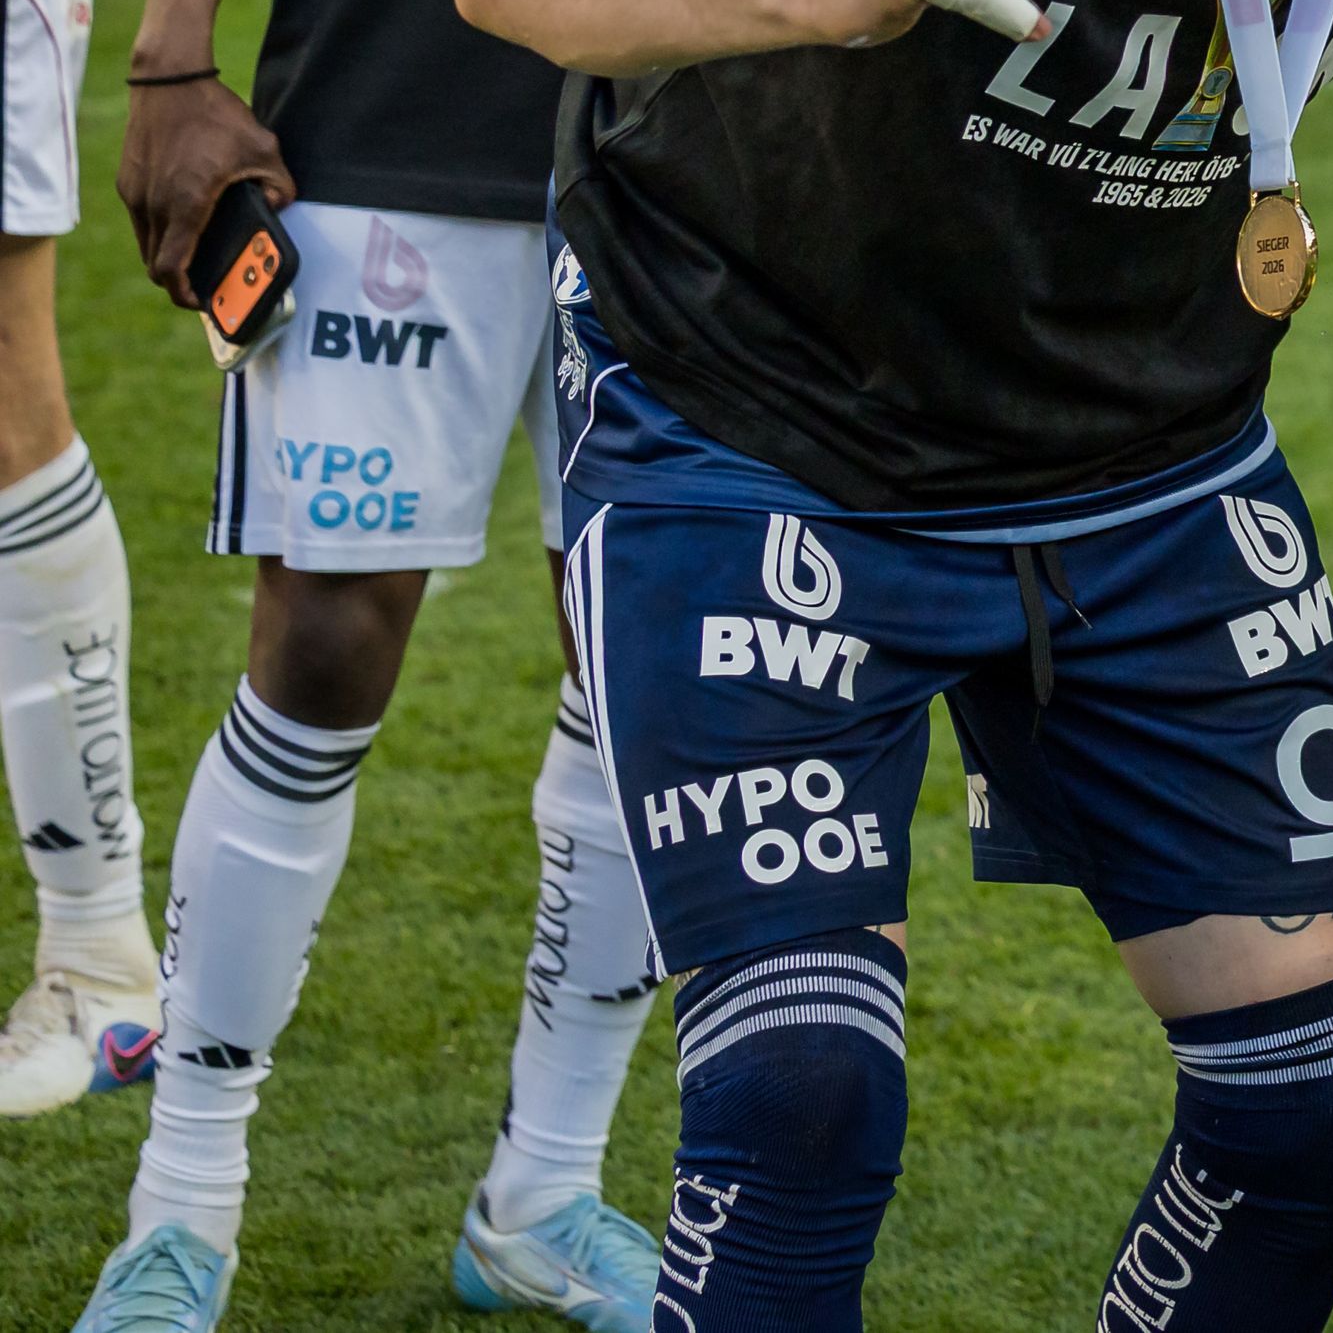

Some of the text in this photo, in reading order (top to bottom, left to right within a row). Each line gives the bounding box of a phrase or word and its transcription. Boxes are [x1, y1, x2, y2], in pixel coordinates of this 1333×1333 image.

[962, 114, 988, 143] ES
[992, 122, 1047, 161] WAR
[1047, 143, 1078, 168] VÜ
[1078, 148, 1152, 179] Z'LANG
[1156, 159, 1200, 183] HER!
[1092, 180, 1212, 209] 1965 & 2026
[1256, 236, 1289, 254] SIEGER
[1261, 259, 1285, 275] 2026
[311, 310, 448, 370] BWT
[276, 439, 393, 486] YPO
[309, 490, 421, 532] OOE
[699, 615, 872, 702] BWT
[643, 758, 845, 851] HYPO
[741, 813, 889, 884] OOE
